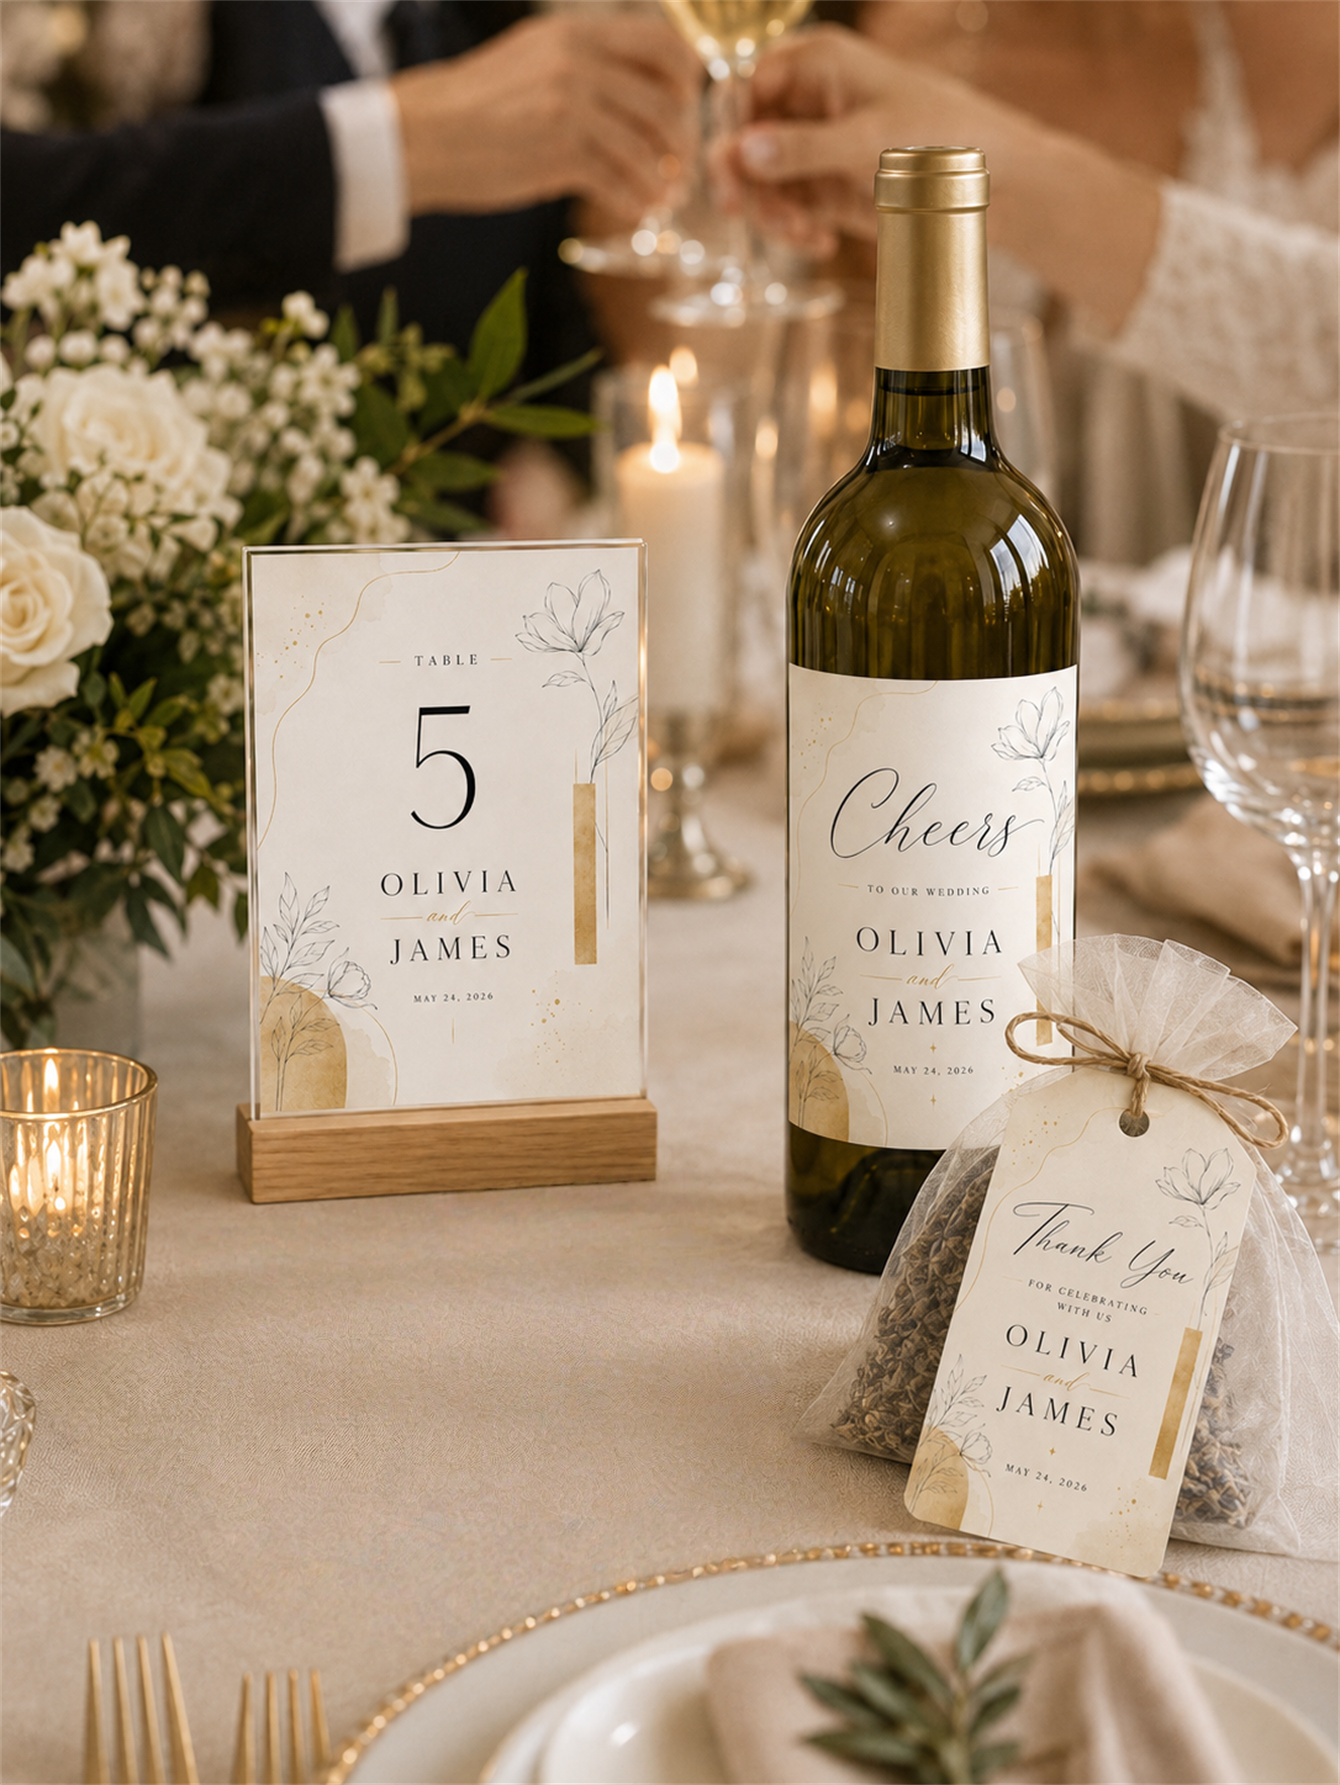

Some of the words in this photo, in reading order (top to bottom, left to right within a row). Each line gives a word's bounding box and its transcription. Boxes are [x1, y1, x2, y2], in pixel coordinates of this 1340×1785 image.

[414, 653, 478, 667] TABLE
[410, 705, 476, 830] 5
[829, 767, 1045, 859] Cheers
[380, 869, 516, 896] OLIVIA
[867, 884, 884, 894] TO
[890, 886, 919, 896] OUR
[925, 887, 989, 897] WEDDING
[426, 900, 474, 926] and
[389, 935, 511, 965] JAMES
[856, 926, 1001, 957] OLIVIA
[906, 963, 955, 990] and
[413, 994, 437, 1003] MAY
[443, 993, 461, 1002] 24,
[466, 992, 494, 1002] 2026
[867, 997, 995, 1026] JAMES
[893, 1065, 916, 1075] MAY
[923, 1066, 941, 1076] 24,
[948, 1066, 974, 1076] 2026
[1012, 1201, 1124, 1263] Thank
[1120, 1239, 1194, 1290] You
[1028, 1278, 1052, 1293] FOR
[1057, 1285, 1148, 1316] CELEBRATING
[1057, 1300, 1092, 1318] WITH
[1096, 1311, 1112, 1323] US
[1006, 1324, 1137, 1378] OLIVIA
[1042, 1372, 1090, 1392] and
[995, 1386, 1118, 1436] JAMES
[1005, 1463, 1030, 1477] MAY
[1035, 1471, 1053, 1485] 24,
[1058, 1477, 1088, 1492] 2026
